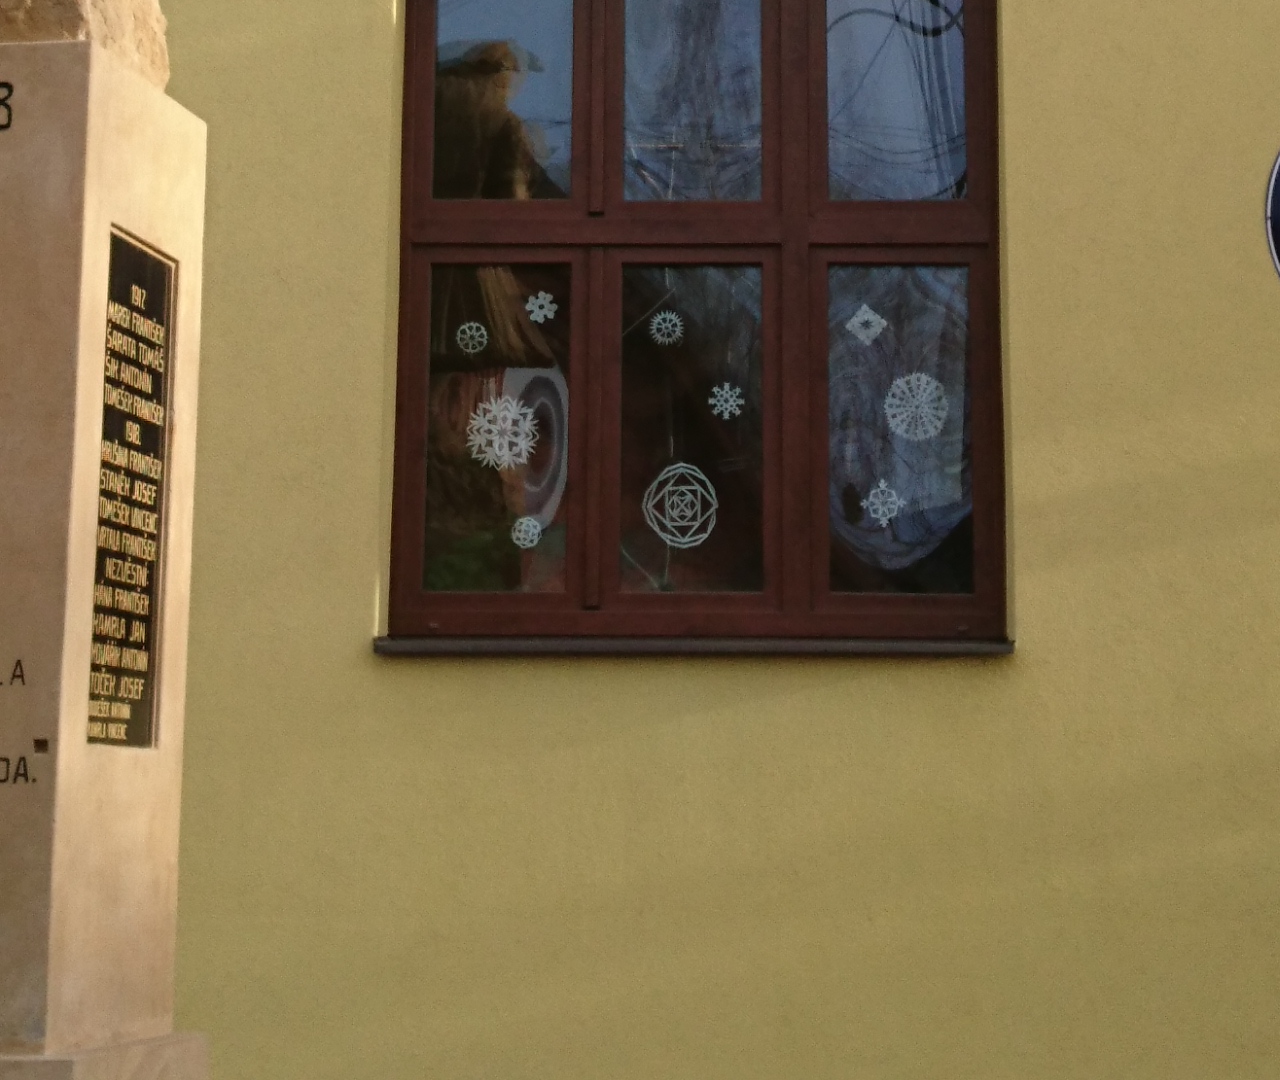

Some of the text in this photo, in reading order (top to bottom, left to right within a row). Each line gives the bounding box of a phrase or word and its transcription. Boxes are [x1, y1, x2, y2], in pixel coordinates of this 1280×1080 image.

[132, 312, 164, 346] FRANTIŠEK
[138, 342, 164, 372] TOMÁŠ
[132, 479, 157, 505] JOSEF
[129, 620, 146, 643] JAN
[118, 677, 145, 700] JOSEF
